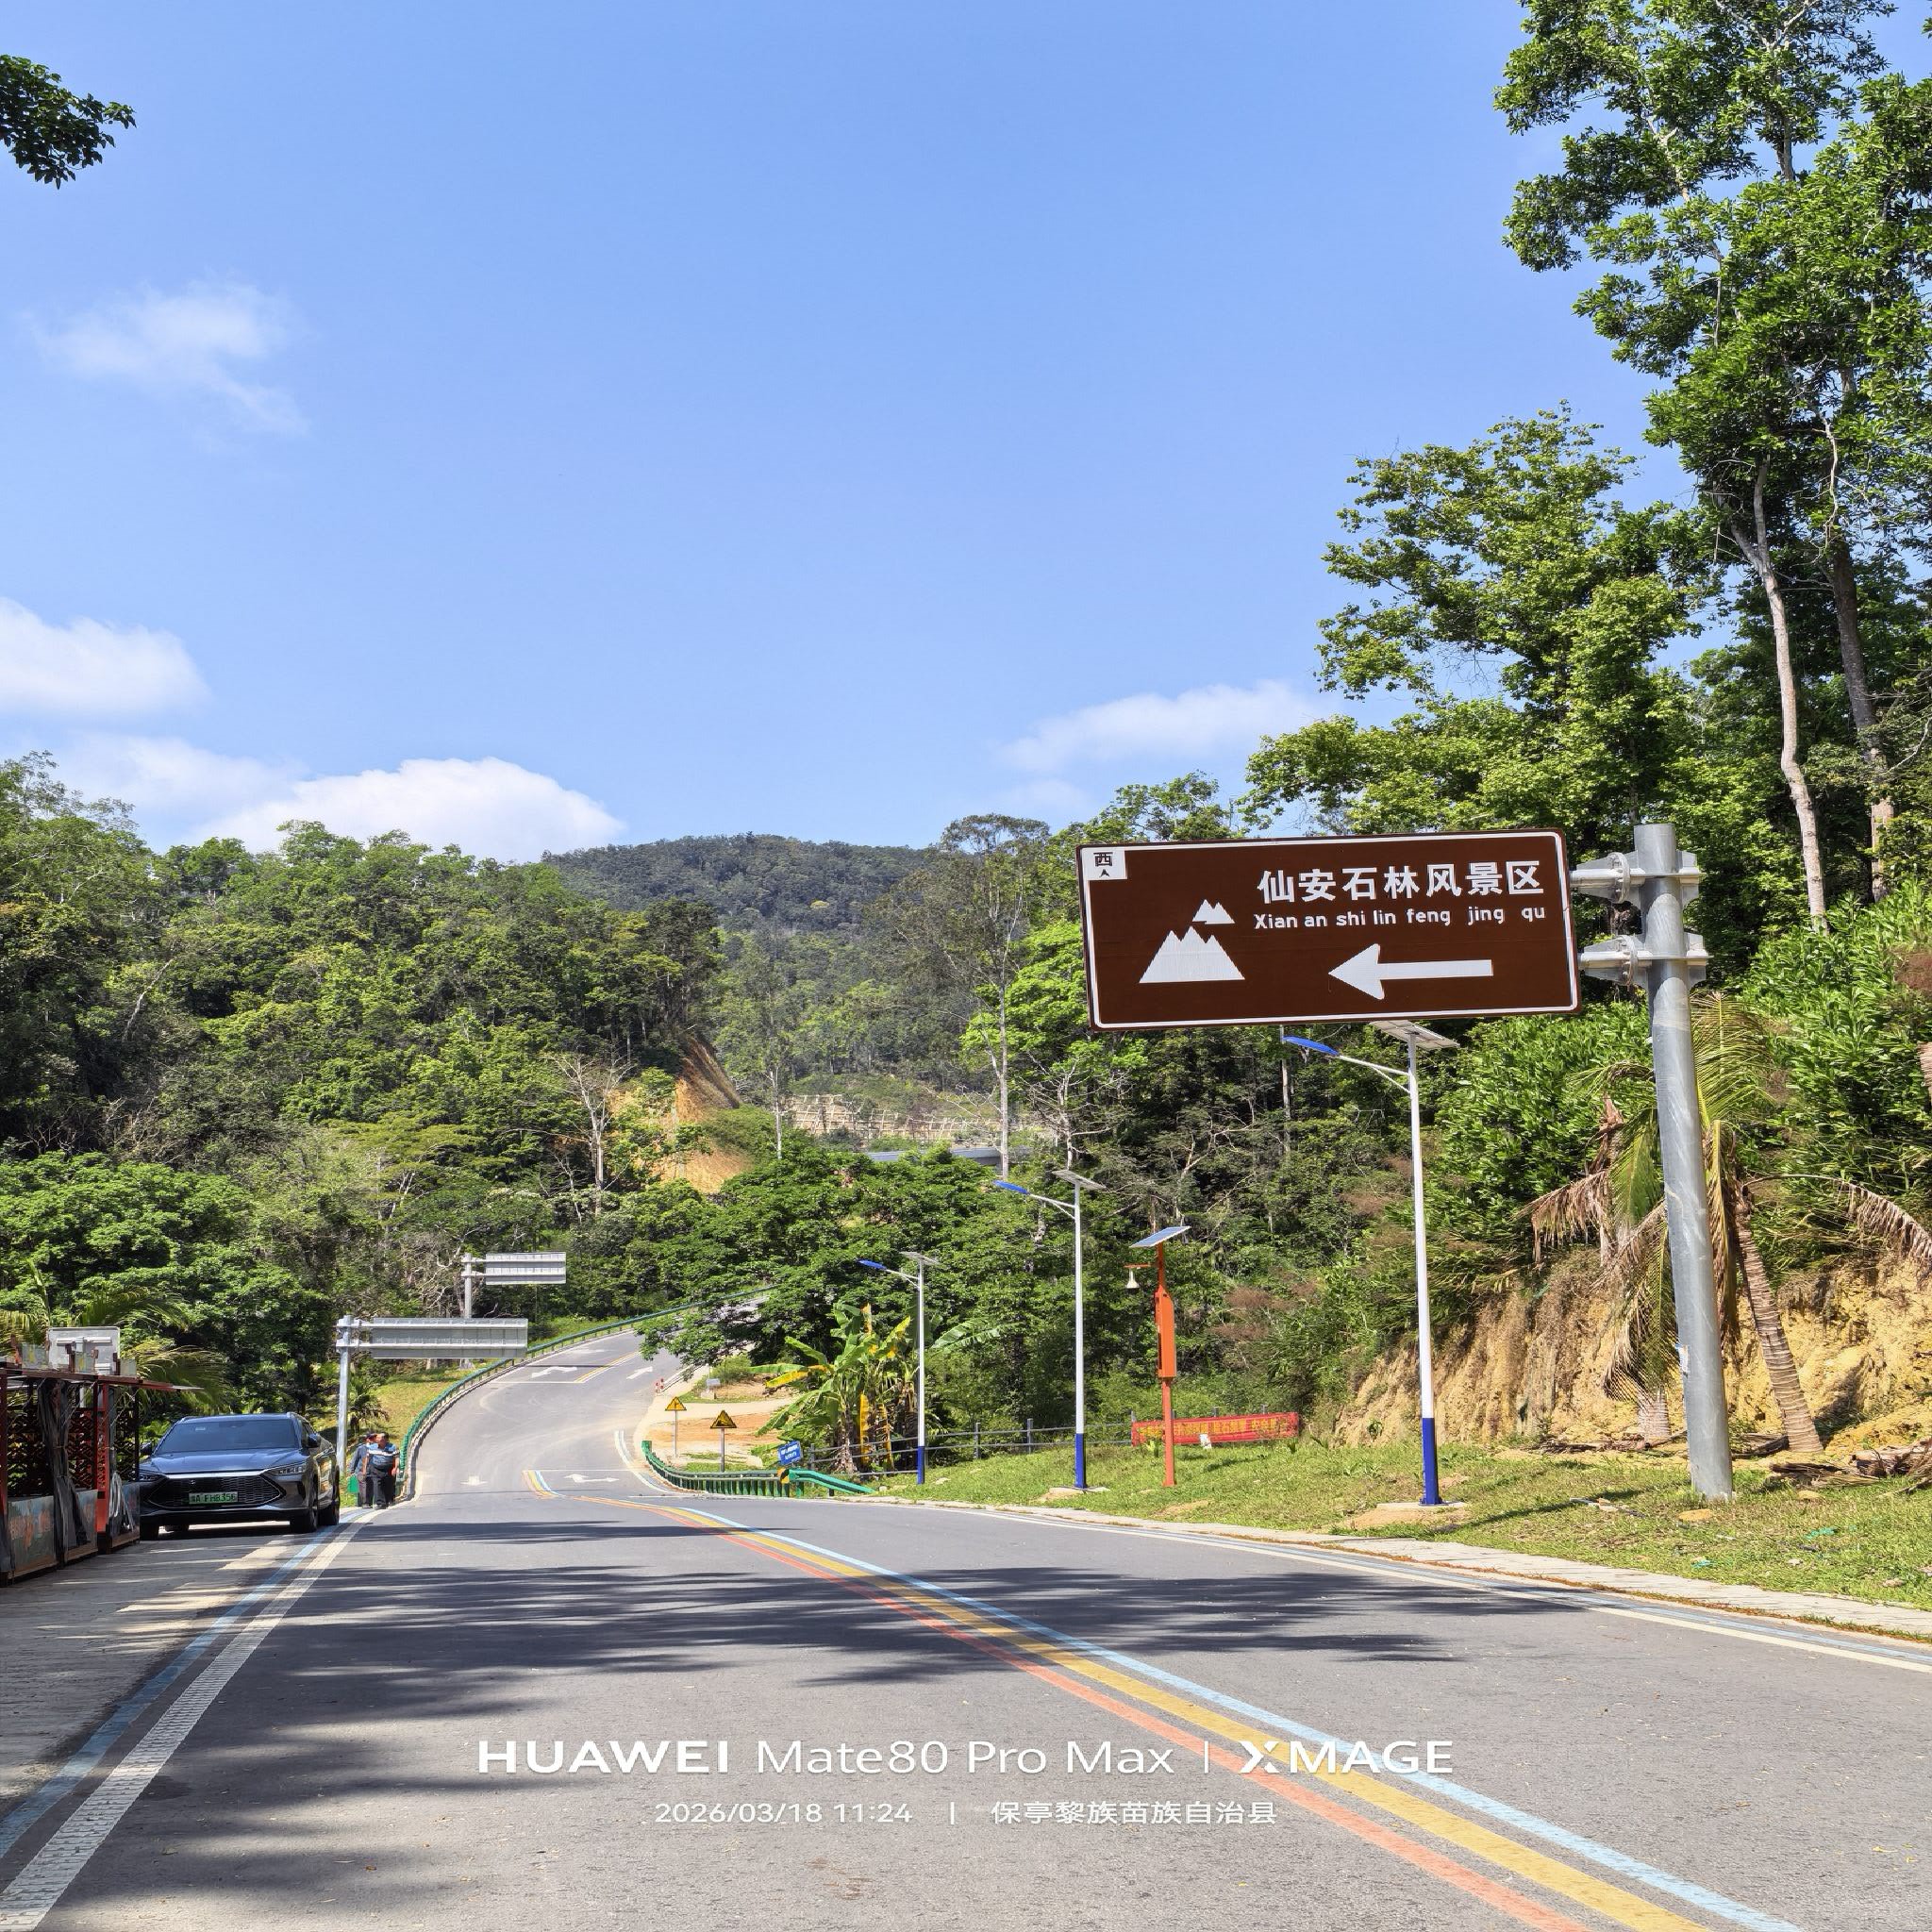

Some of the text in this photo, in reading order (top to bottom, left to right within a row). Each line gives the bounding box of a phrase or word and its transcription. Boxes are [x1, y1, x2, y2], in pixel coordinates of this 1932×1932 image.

[1092, 851, 1113, 867] 西
[1257, 860, 1544, 905] 仙安石林风景区
[1253, 906, 1545, 929] Xian an shi lin feng jing qu
